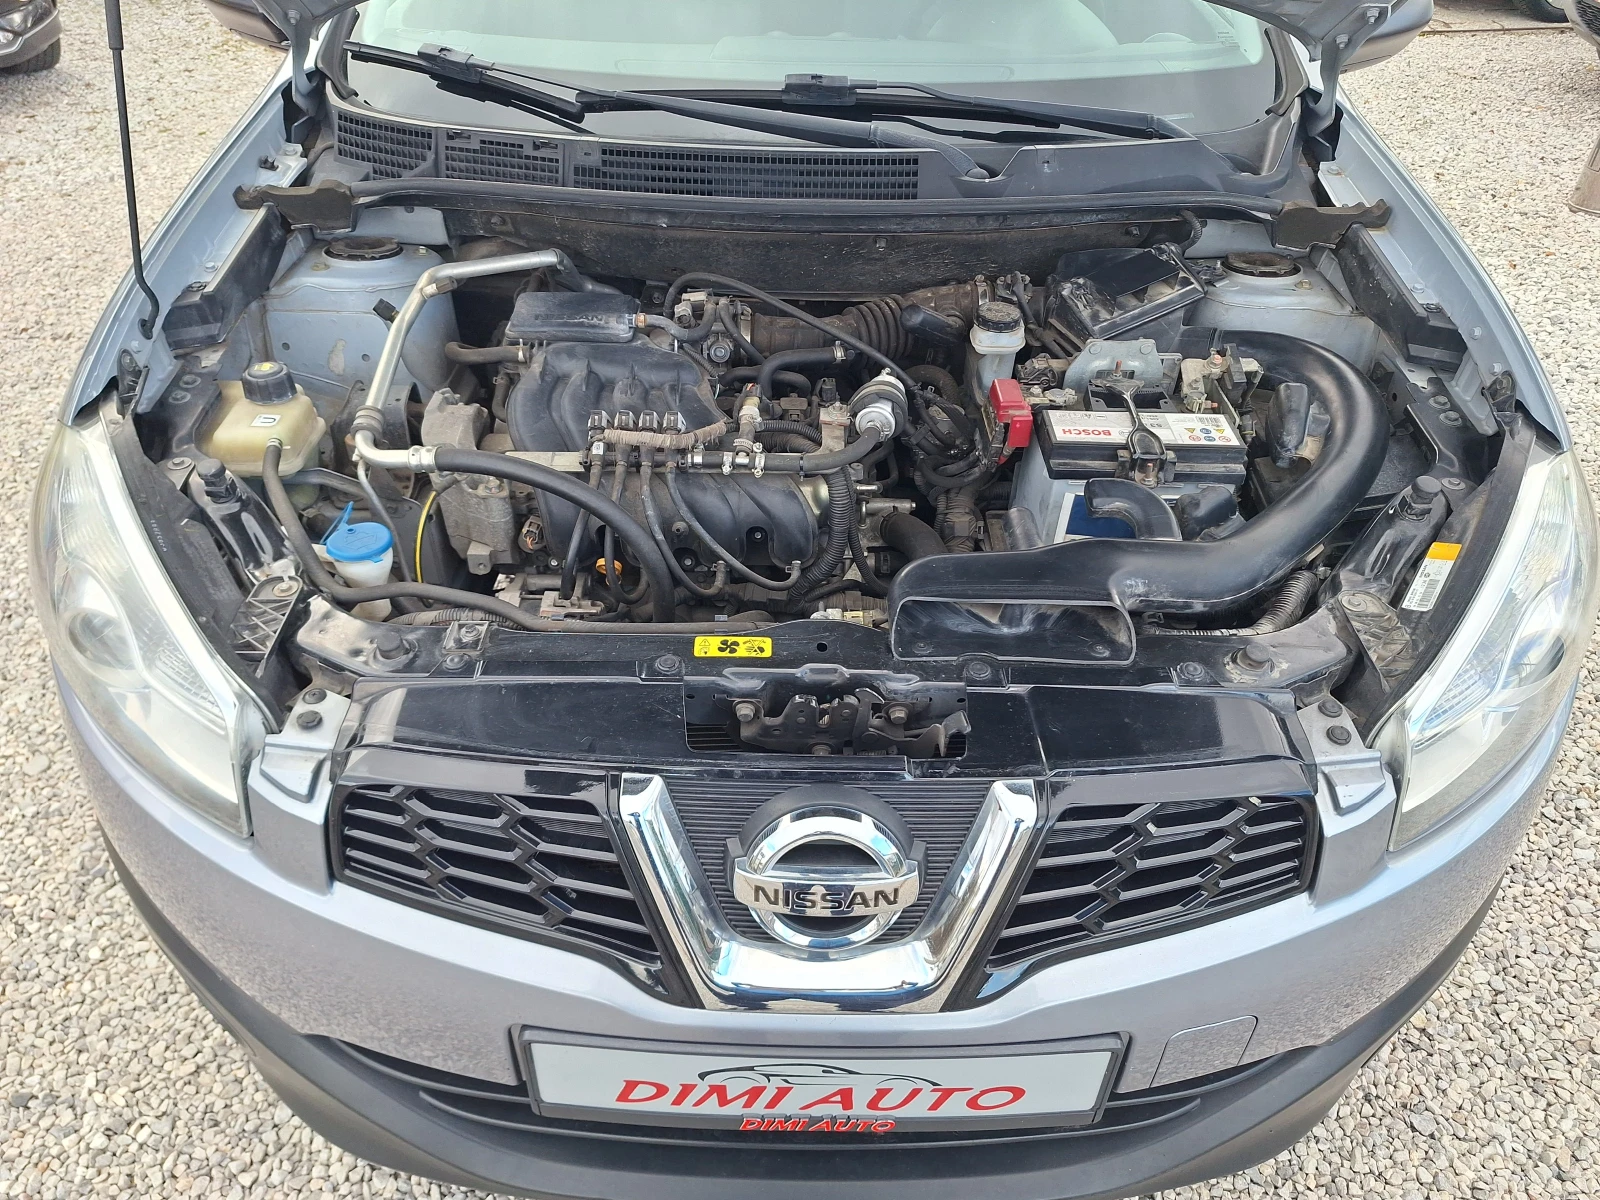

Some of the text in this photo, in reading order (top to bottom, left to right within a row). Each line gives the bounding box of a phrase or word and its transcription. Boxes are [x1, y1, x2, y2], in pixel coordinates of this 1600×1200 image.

[1062, 428, 1111, 437] BOSCH
[753, 884, 900, 910] NISSAN
[614, 1079, 1027, 1112] DIMI AUTO
[739, 1117, 897, 1133] DIMI AUTO
